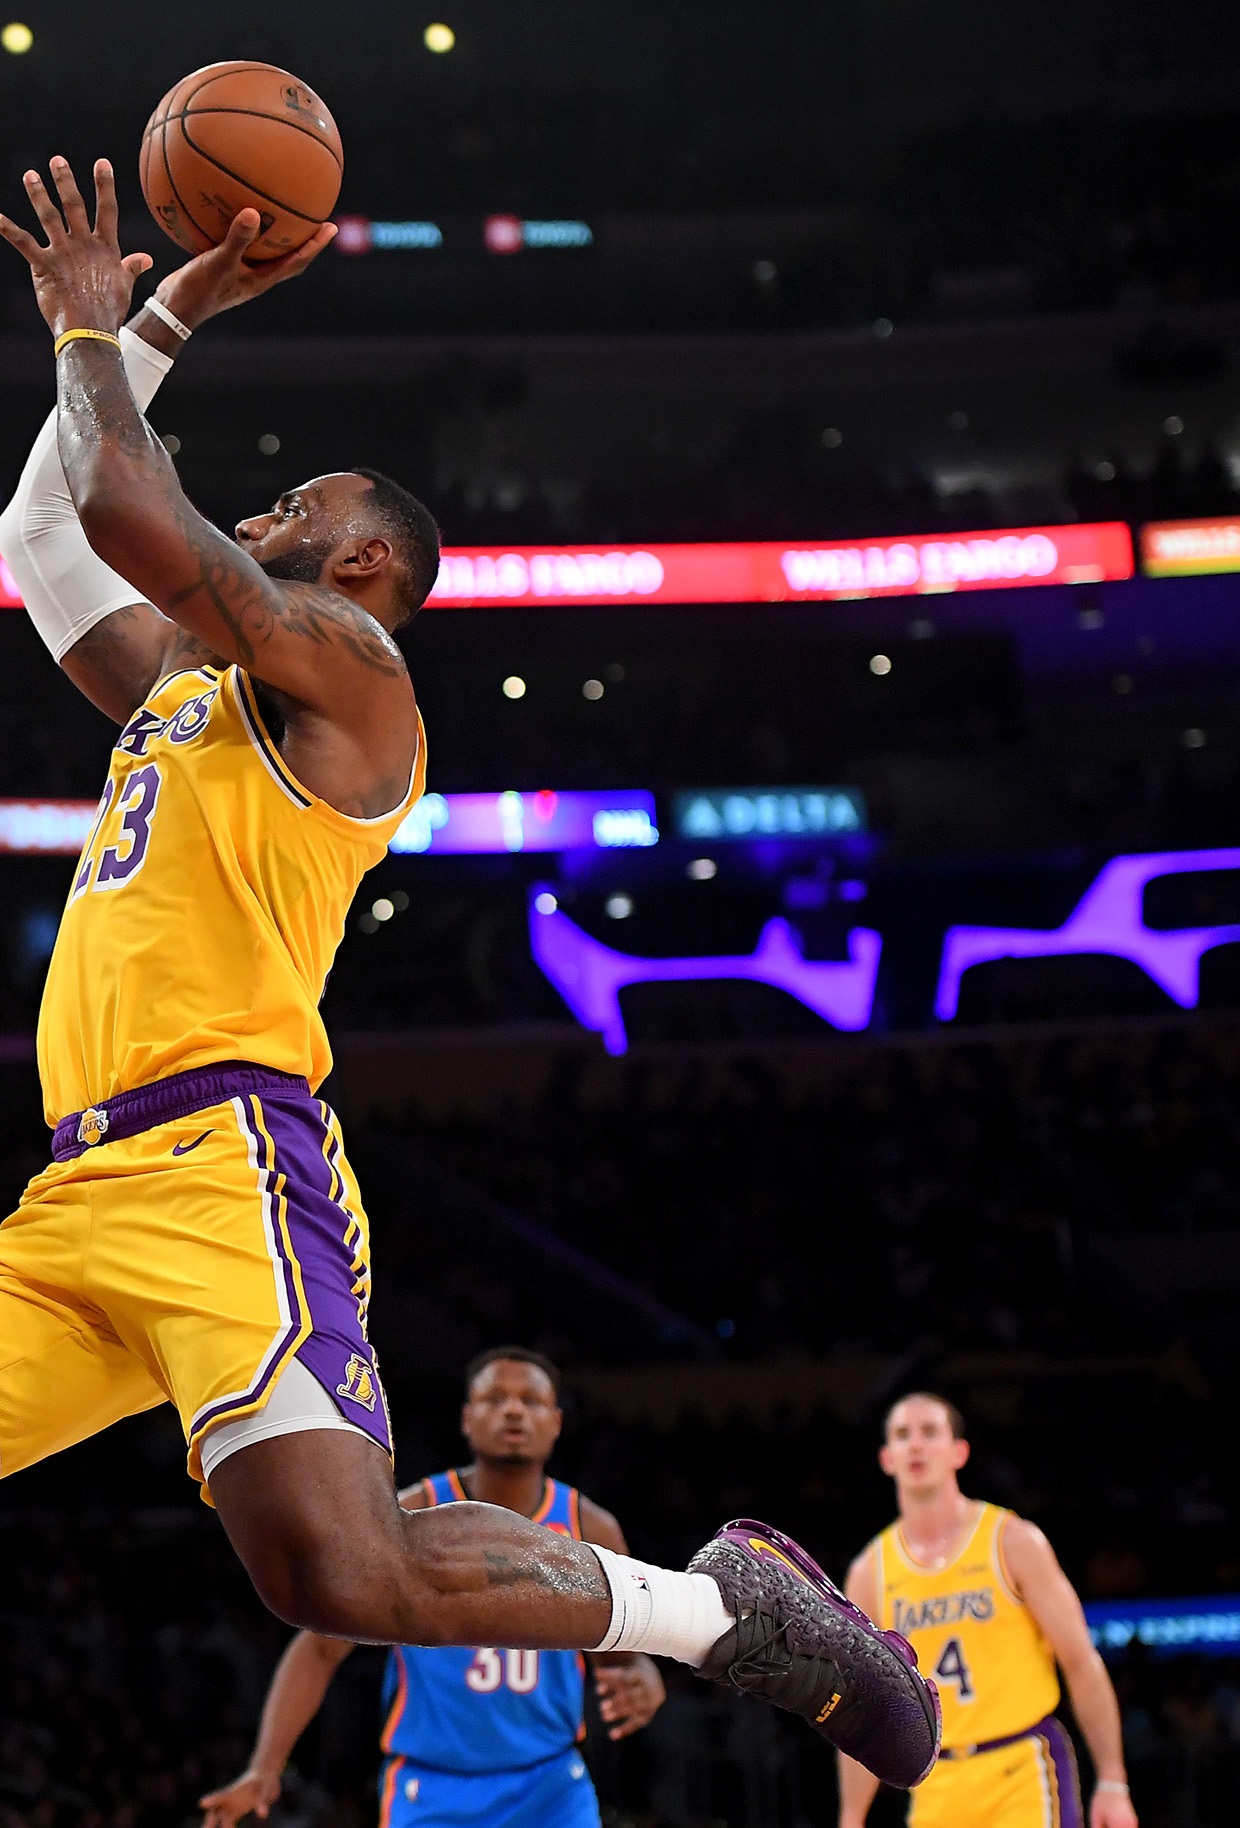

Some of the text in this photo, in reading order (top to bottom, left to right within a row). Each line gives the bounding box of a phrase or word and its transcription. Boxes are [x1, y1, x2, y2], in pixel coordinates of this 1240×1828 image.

[529, 551, 664, 596] FARGO
[781, 534, 1058, 591] WELLS FARGO
[722, 793, 860, 834] DELTA
[892, 1586, 996, 1637] LAKERS
[465, 1646, 540, 1693] 30
[933, 1637, 976, 1704] 4
